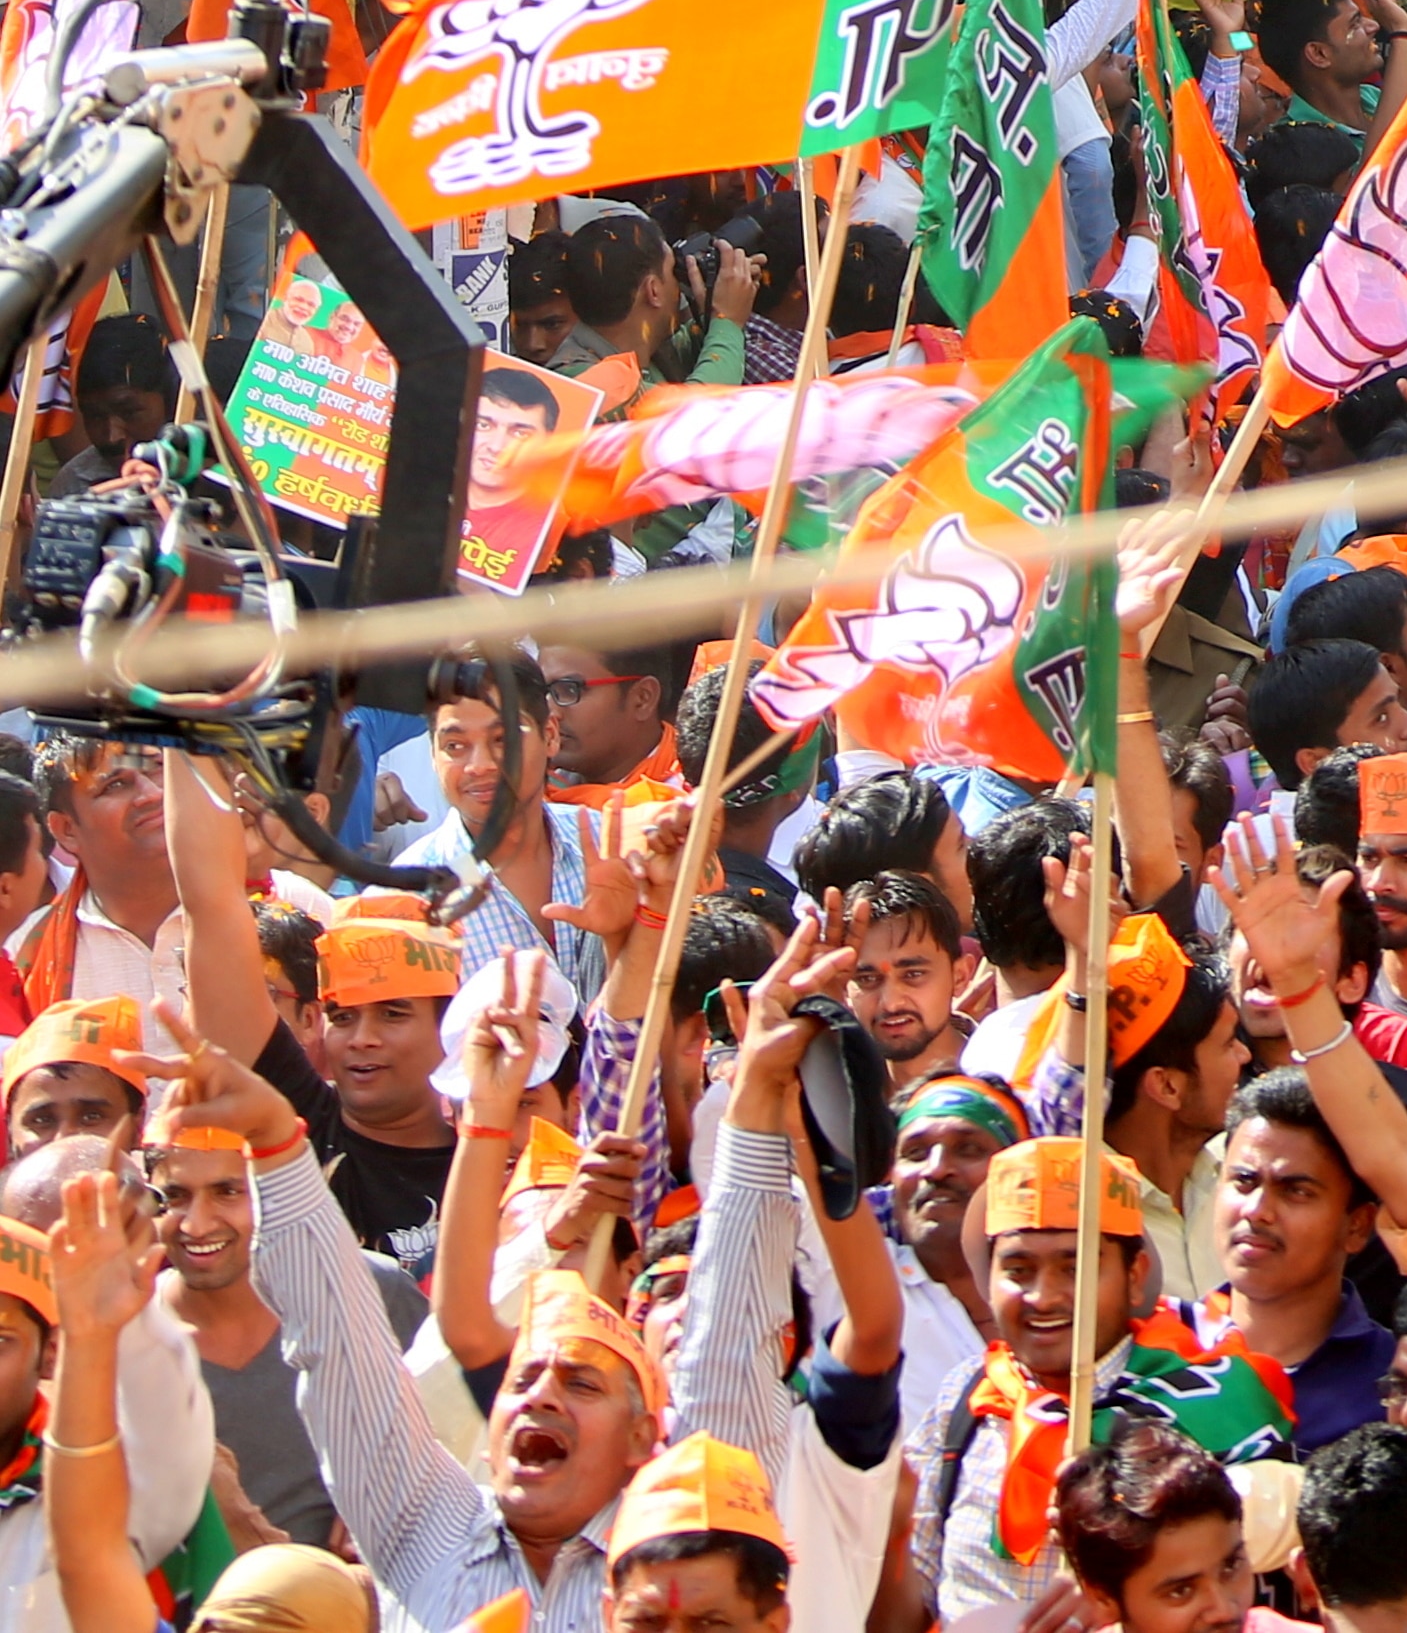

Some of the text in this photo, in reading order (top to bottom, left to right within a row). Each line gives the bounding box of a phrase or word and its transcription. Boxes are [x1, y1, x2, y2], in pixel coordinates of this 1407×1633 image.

[454, 255, 498, 304] BANK
[278, 369, 318, 400] केशव
[317, 386, 357, 415] प्रसाद
[296, 352, 352, 385] अमित
[352, 374, 390, 402] शाह
